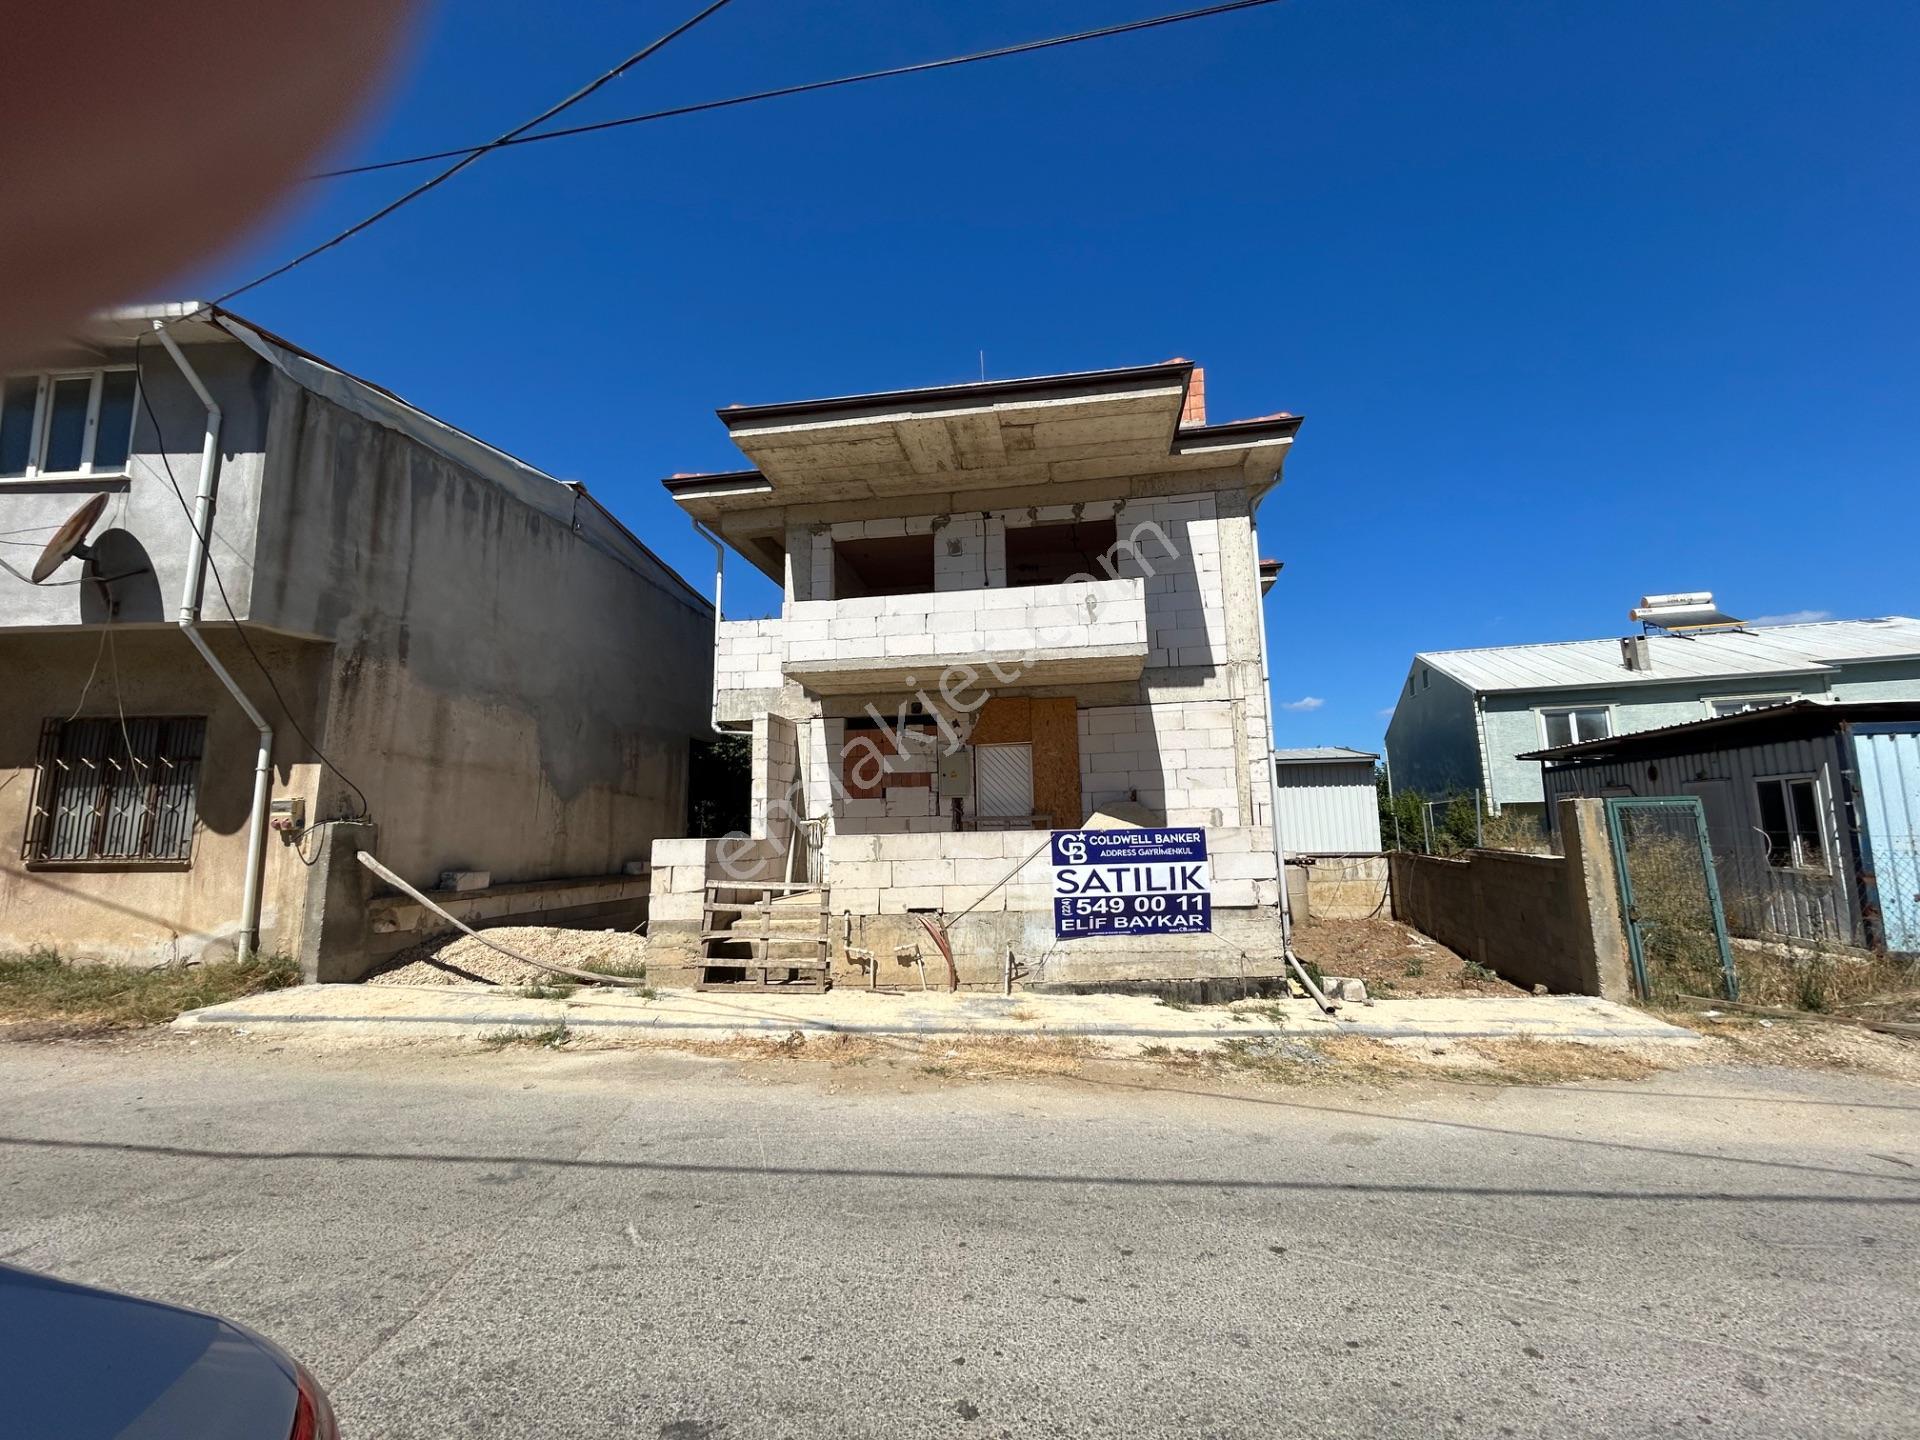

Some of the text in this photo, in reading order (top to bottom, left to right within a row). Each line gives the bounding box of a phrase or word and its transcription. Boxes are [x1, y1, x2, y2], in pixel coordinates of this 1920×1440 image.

[1089, 832, 1201, 845] COLDWELL BANKER
[1100, 847, 1193, 857] ADDRESS GAYRİMENKUL
[1056, 865, 1205, 894] SATILIK
[1076, 898, 1125, 915] 549
[1134, 896, 1166, 913] 00
[1176, 895, 1203, 911] 11
[1114, 914, 1204, 929] BAYKAR
